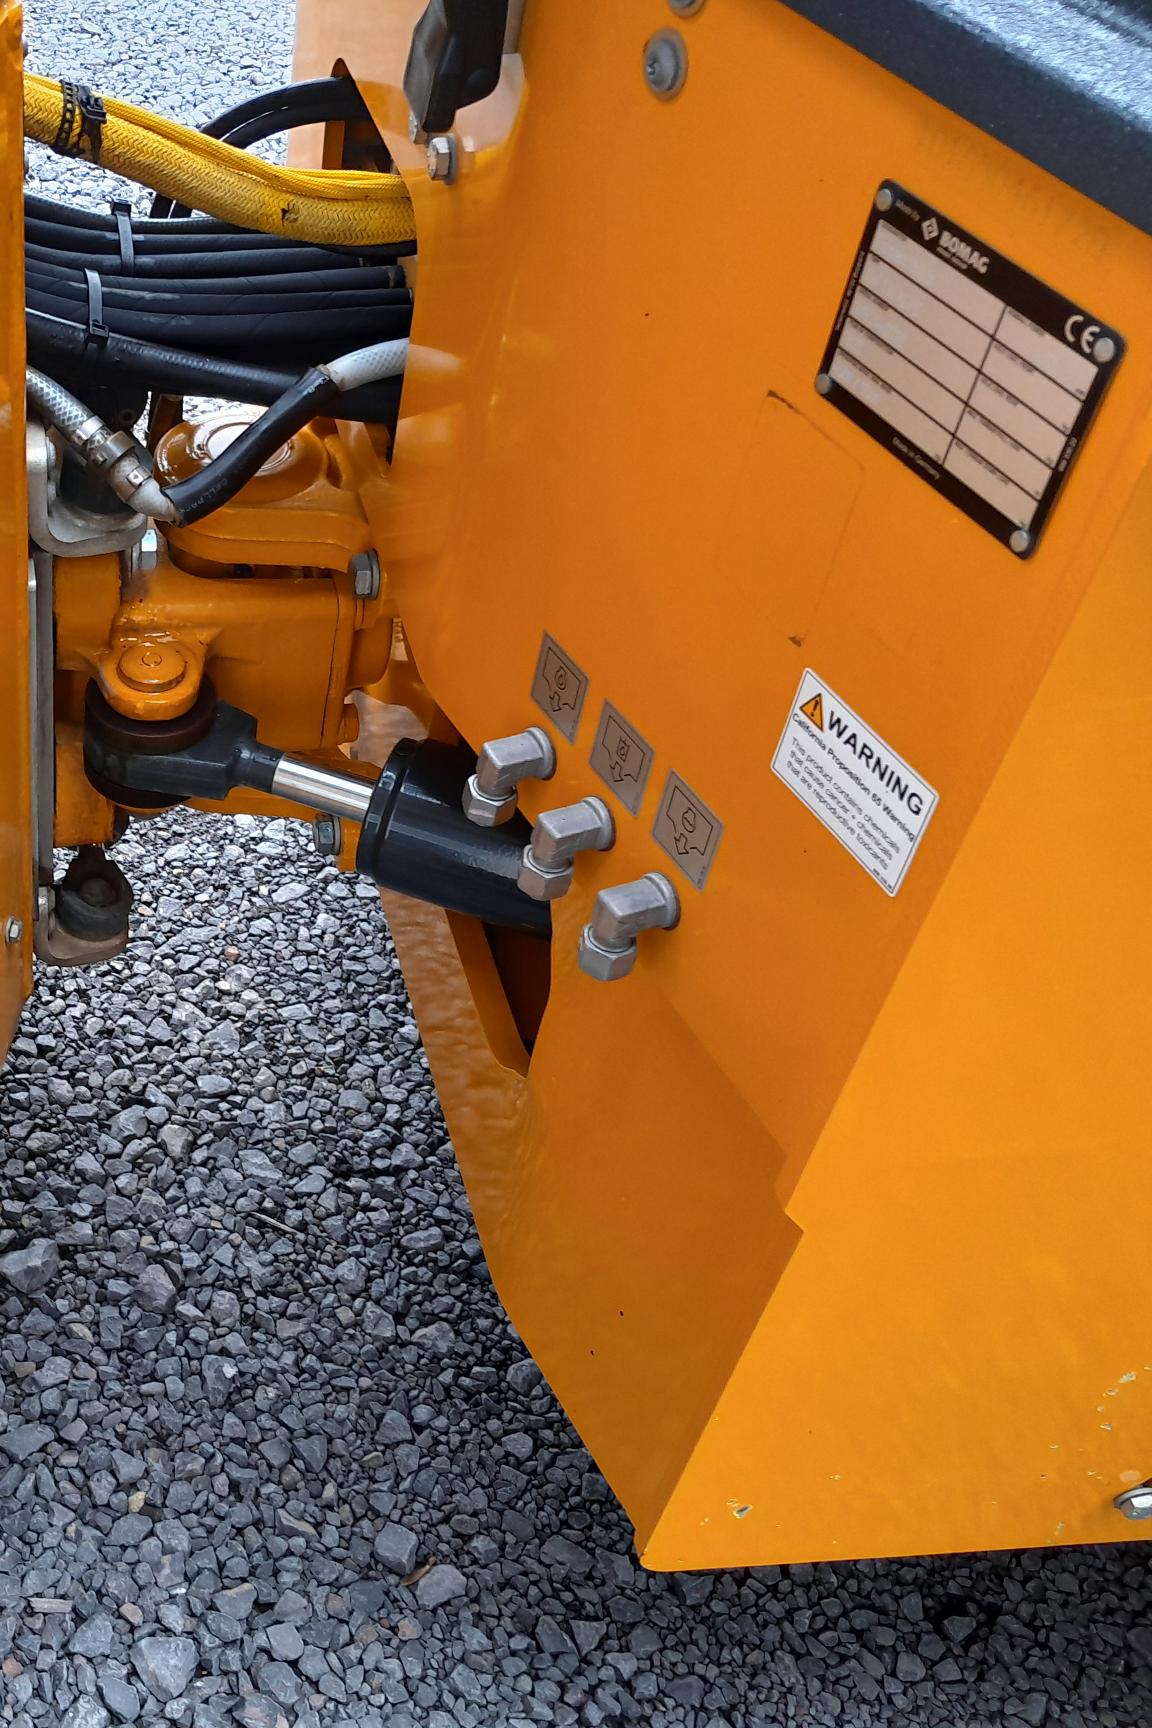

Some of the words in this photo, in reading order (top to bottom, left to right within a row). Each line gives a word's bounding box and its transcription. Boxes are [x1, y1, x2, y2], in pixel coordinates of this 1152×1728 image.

[938, 229, 990, 275] BOMAG
[1064, 314, 1101, 354] CE
[786, 758, 800, 777] that
[800, 774, 812, 791] are
[811, 786, 856, 837] reproductive
[855, 831, 889, 871] toxicants
[789, 749, 803, 767] that
[803, 764, 824, 790] cause
[824, 787, 849, 815] cancer
[856, 818, 893, 861] chemicals
[791, 736, 806, 756] This
[805, 752, 833, 785] product
[832, 780, 863, 815] contains
[863, 810, 901, 854] chemicals
[792, 711, 827, 751] California
[826, 747, 871, 797] Proposition
[871, 792, 882, 807] 65
[880, 802, 916, 843] Warning
[825, 709, 925, 818] WARNING
